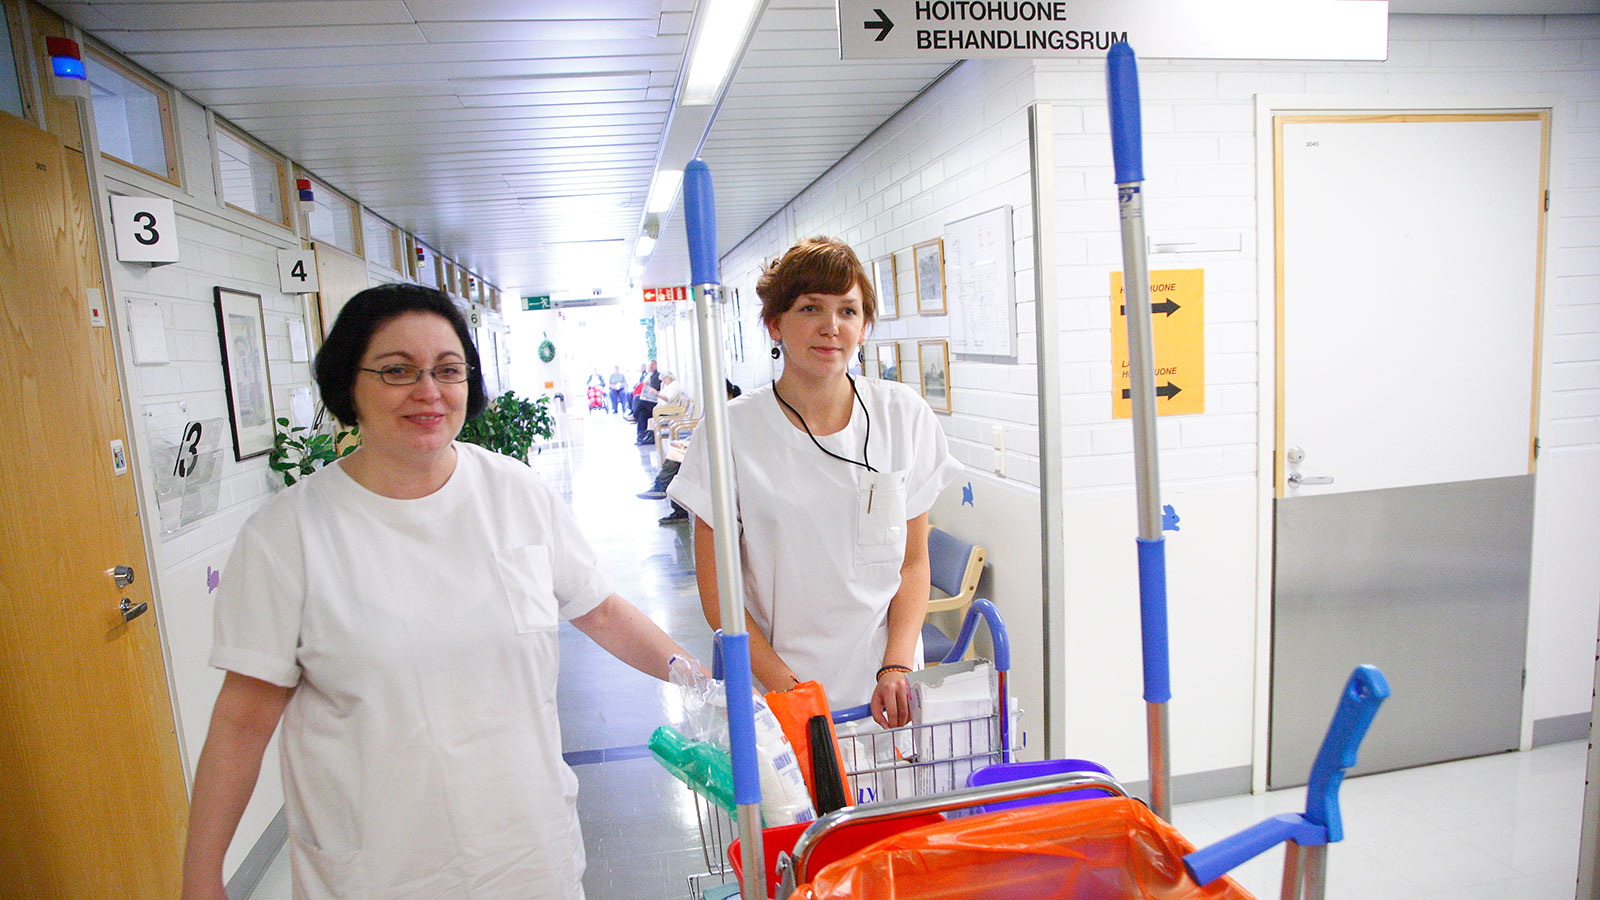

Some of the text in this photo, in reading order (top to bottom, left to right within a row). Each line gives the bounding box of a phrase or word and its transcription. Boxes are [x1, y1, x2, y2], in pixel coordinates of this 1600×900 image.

[915, 1, 1067, 21] HOITOHUONE
[916, 30, 1128, 50] BEHANDLINGSRUM
[133, 211, 160, 246] 3
[290, 259, 308, 282] 4
[470, 313, 478, 324] 6
[178, 422, 203, 478] 3
